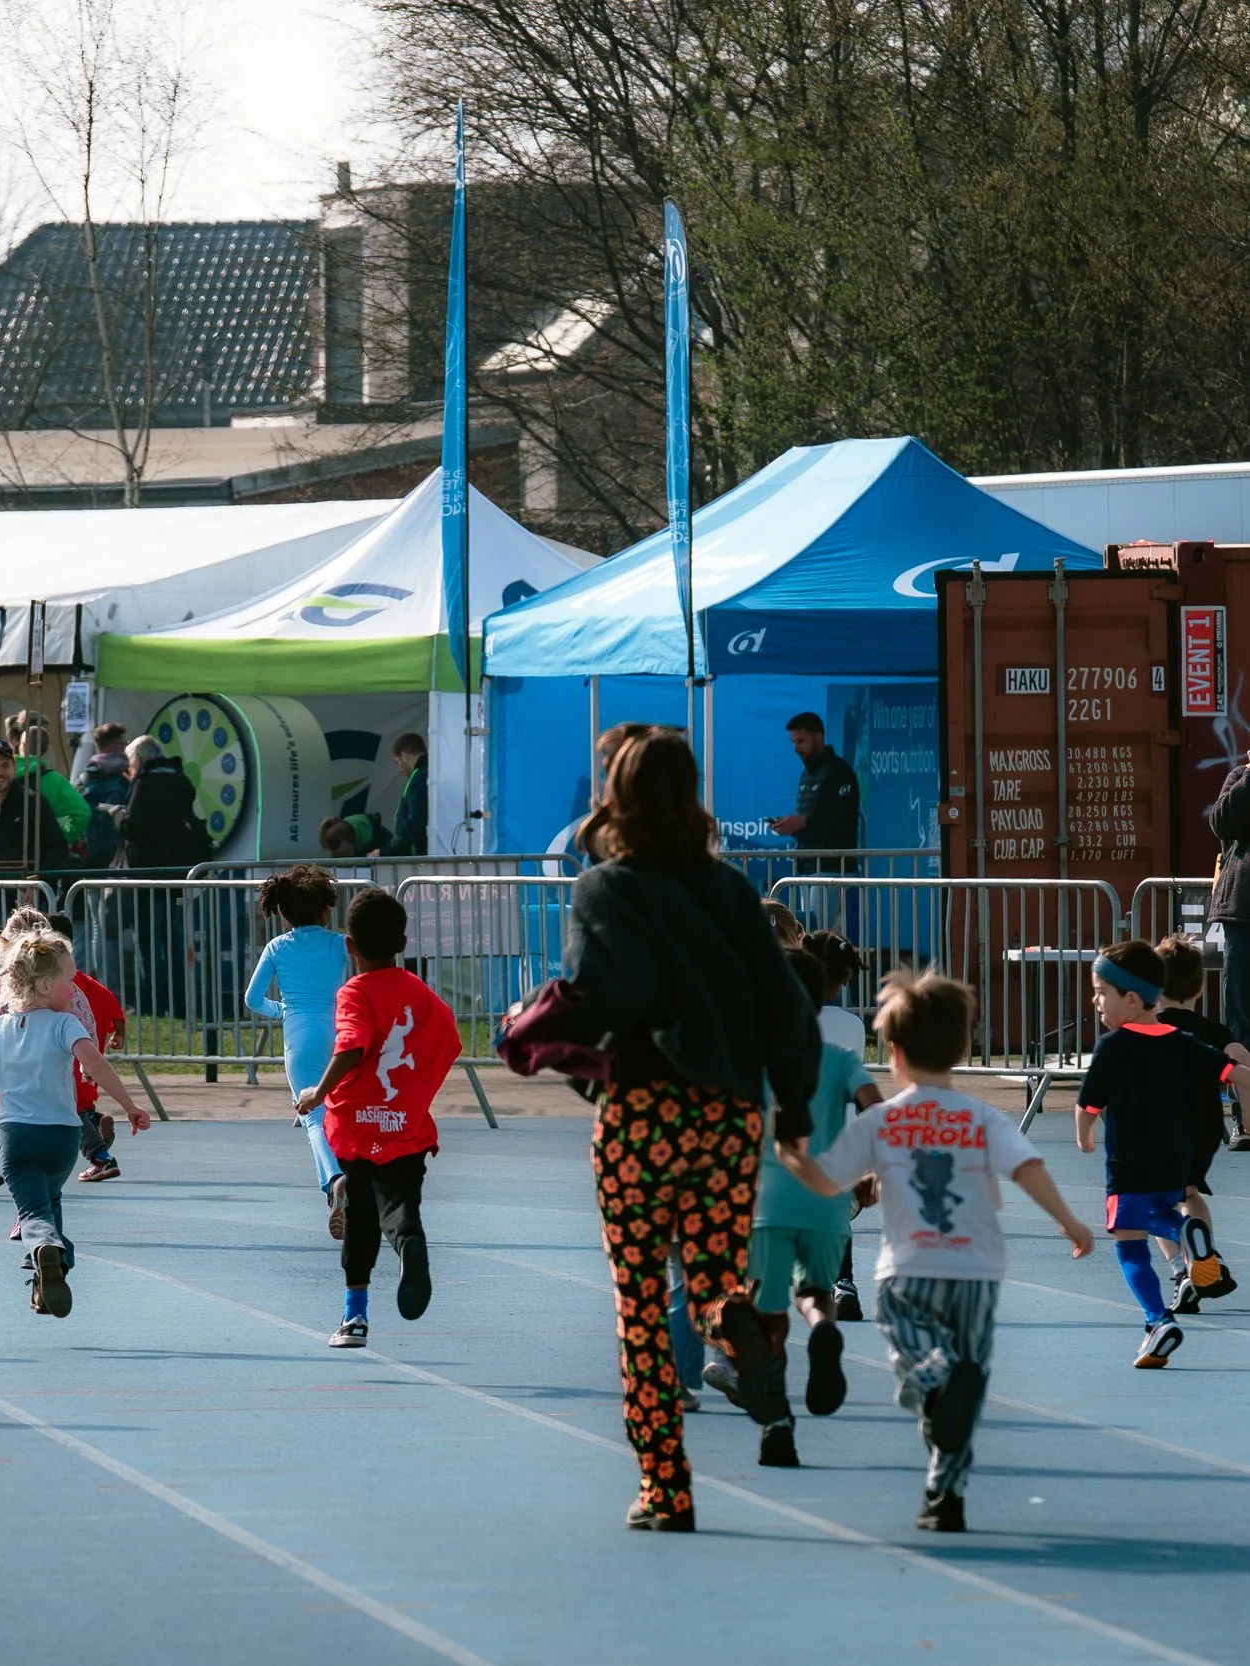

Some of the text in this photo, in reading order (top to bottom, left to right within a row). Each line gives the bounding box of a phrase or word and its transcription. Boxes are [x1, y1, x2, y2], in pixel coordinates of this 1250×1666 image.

[1188, 616, 1210, 705] EVENT 1
[1008, 667, 1163, 691] HAKU 277906 4
[1068, 698, 1111, 721] 22G1
[871, 745, 899, 781] sports
[990, 749, 1051, 772] MAXGROSS
[1067, 747, 1132, 760] 30.480 KGS
[1069, 761, 1134, 774] 67.200 LBS
[992, 779, 1022, 802] TARE
[1077, 775, 1135, 789] 2.230 KGS
[290, 774, 299, 822] insures
[1076, 790, 1134, 802] 4.920 LBS
[990, 808, 1044, 831] PAYLOAD
[1068, 805, 1133, 818] 28.250 KGS
[1114, 820, 1135, 831] LBS
[994, 837, 1045, 860] CUB. CAP.
[1078, 834, 1136, 847] 33.2 CUM
[1071, 849, 1135, 861] 1.170 CUFT
[885, 1101, 974, 1126] OUT FOR
[886, 1124, 987, 1150] STROLL
